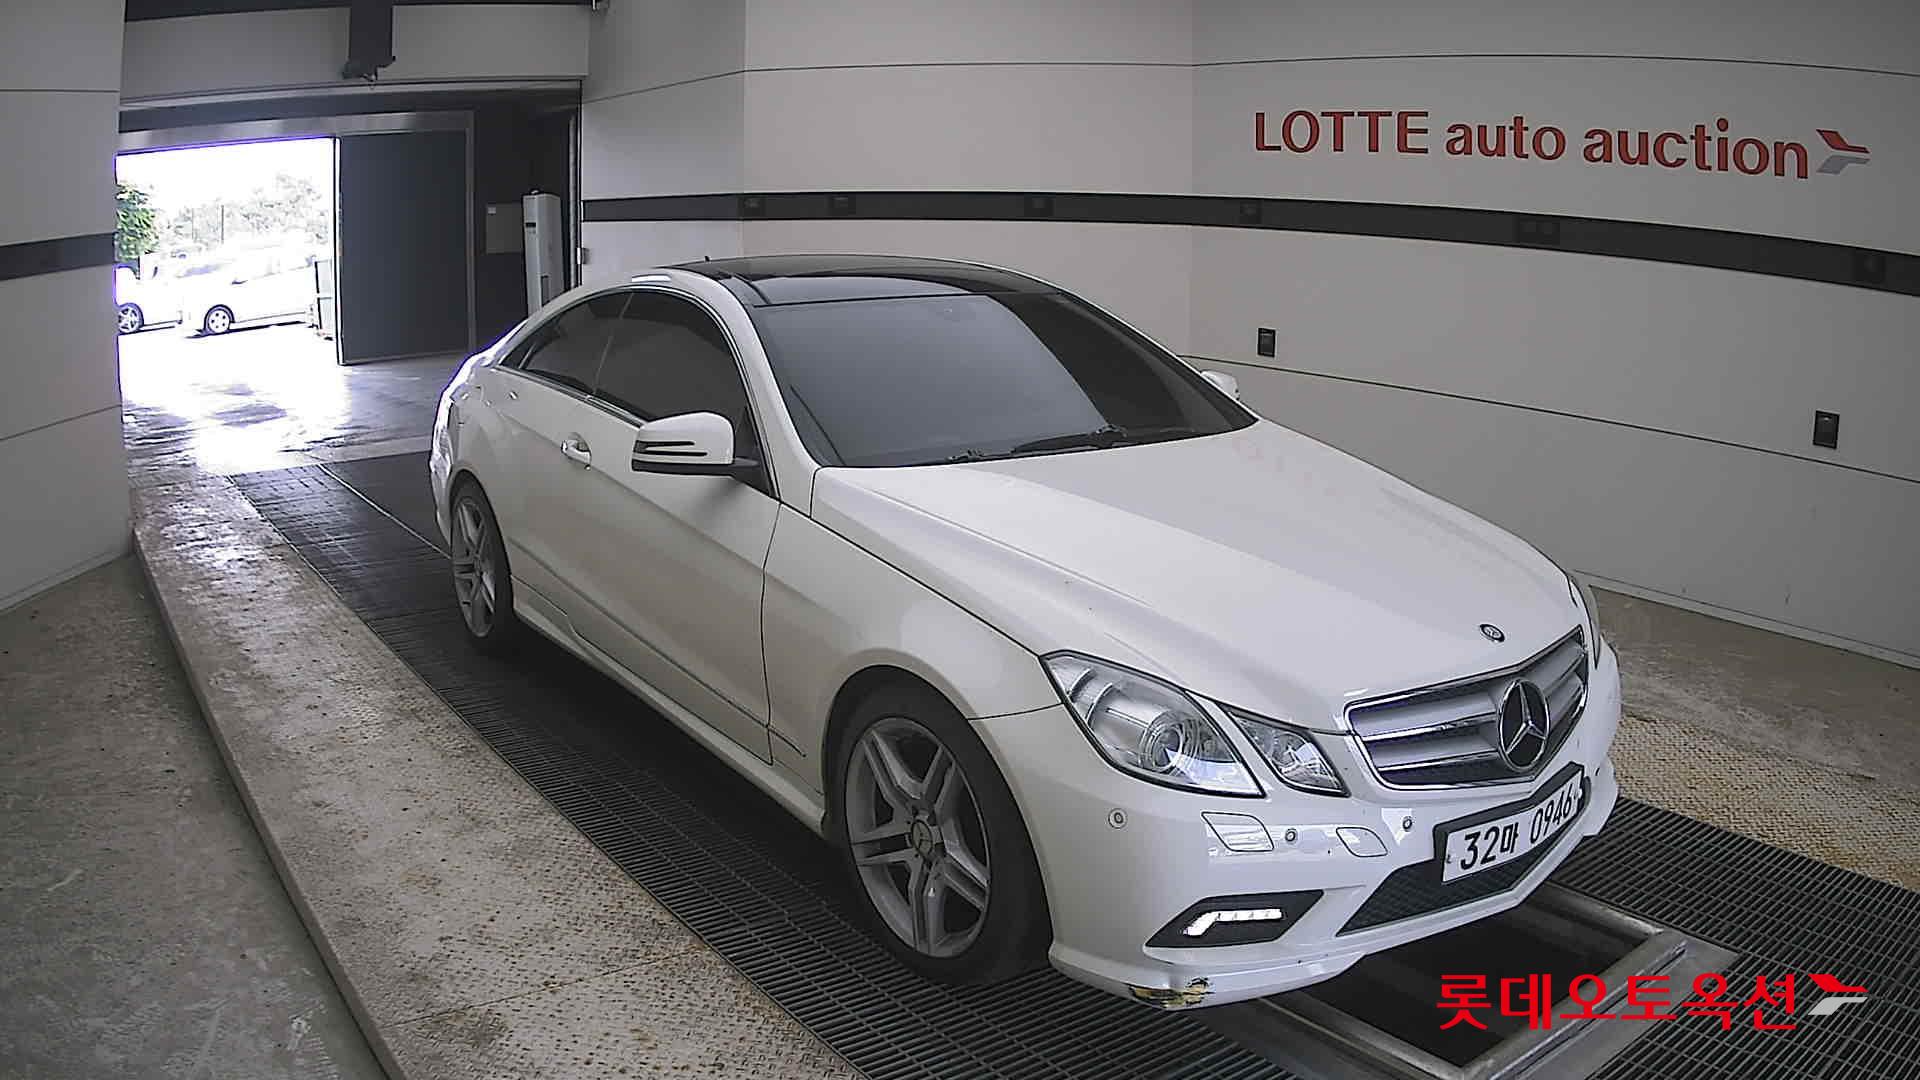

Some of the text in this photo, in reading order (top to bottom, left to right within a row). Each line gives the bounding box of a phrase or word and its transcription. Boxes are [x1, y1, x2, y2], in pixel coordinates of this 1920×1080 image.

[1255, 110, 1809, 179] LOTTE auto auction
[1460, 783, 1573, 870] 32마 0946
